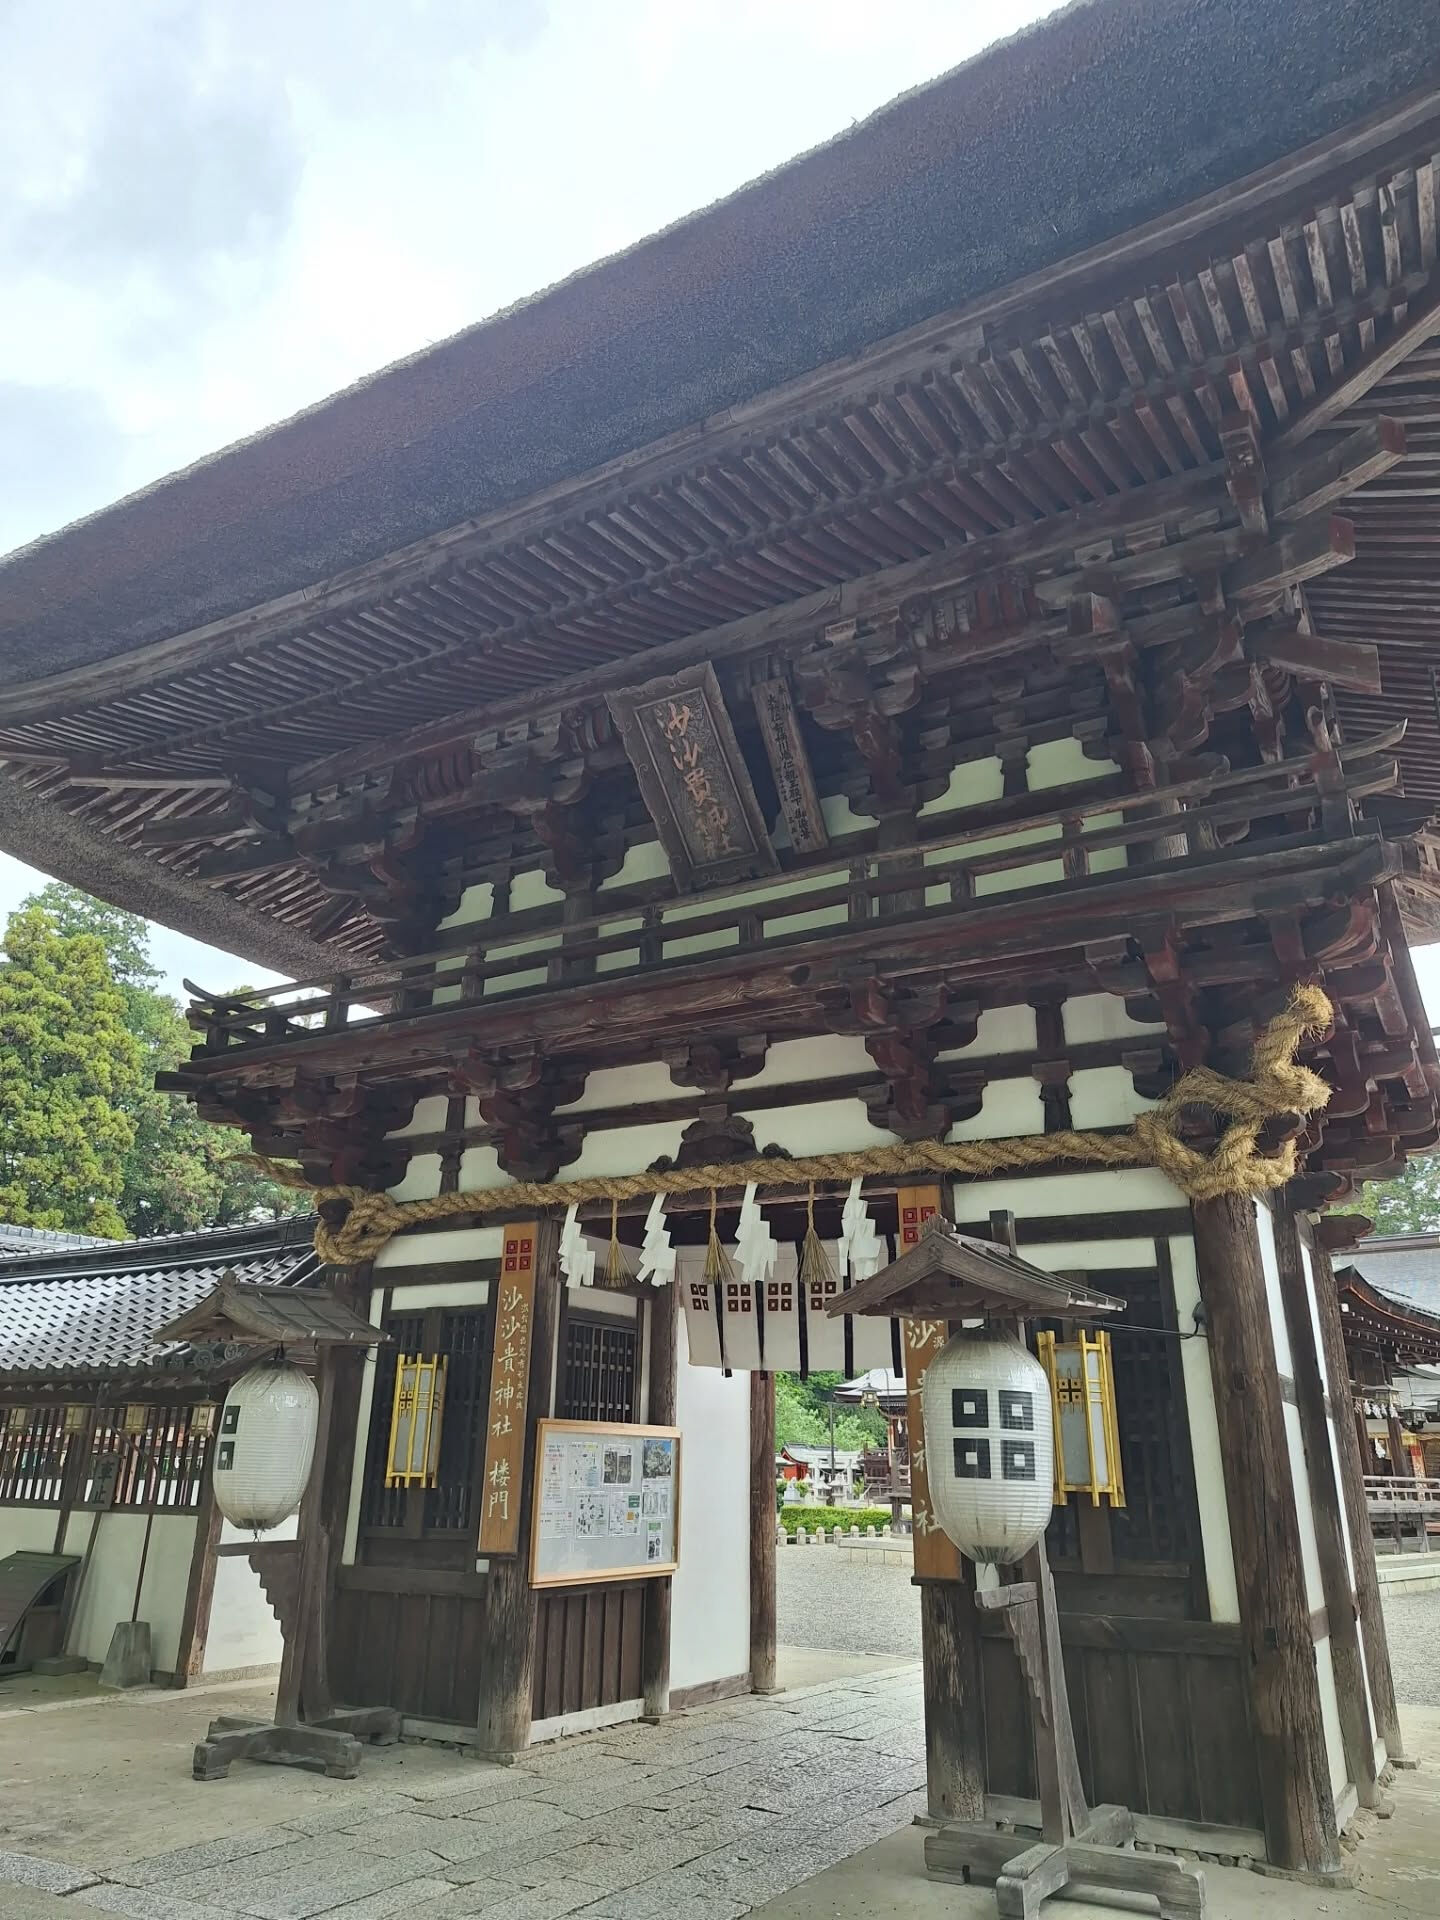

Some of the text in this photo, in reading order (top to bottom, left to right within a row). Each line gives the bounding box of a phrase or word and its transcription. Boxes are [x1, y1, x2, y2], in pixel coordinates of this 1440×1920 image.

[488, 1286, 523, 1520] 沙沙貴神社 楼門
